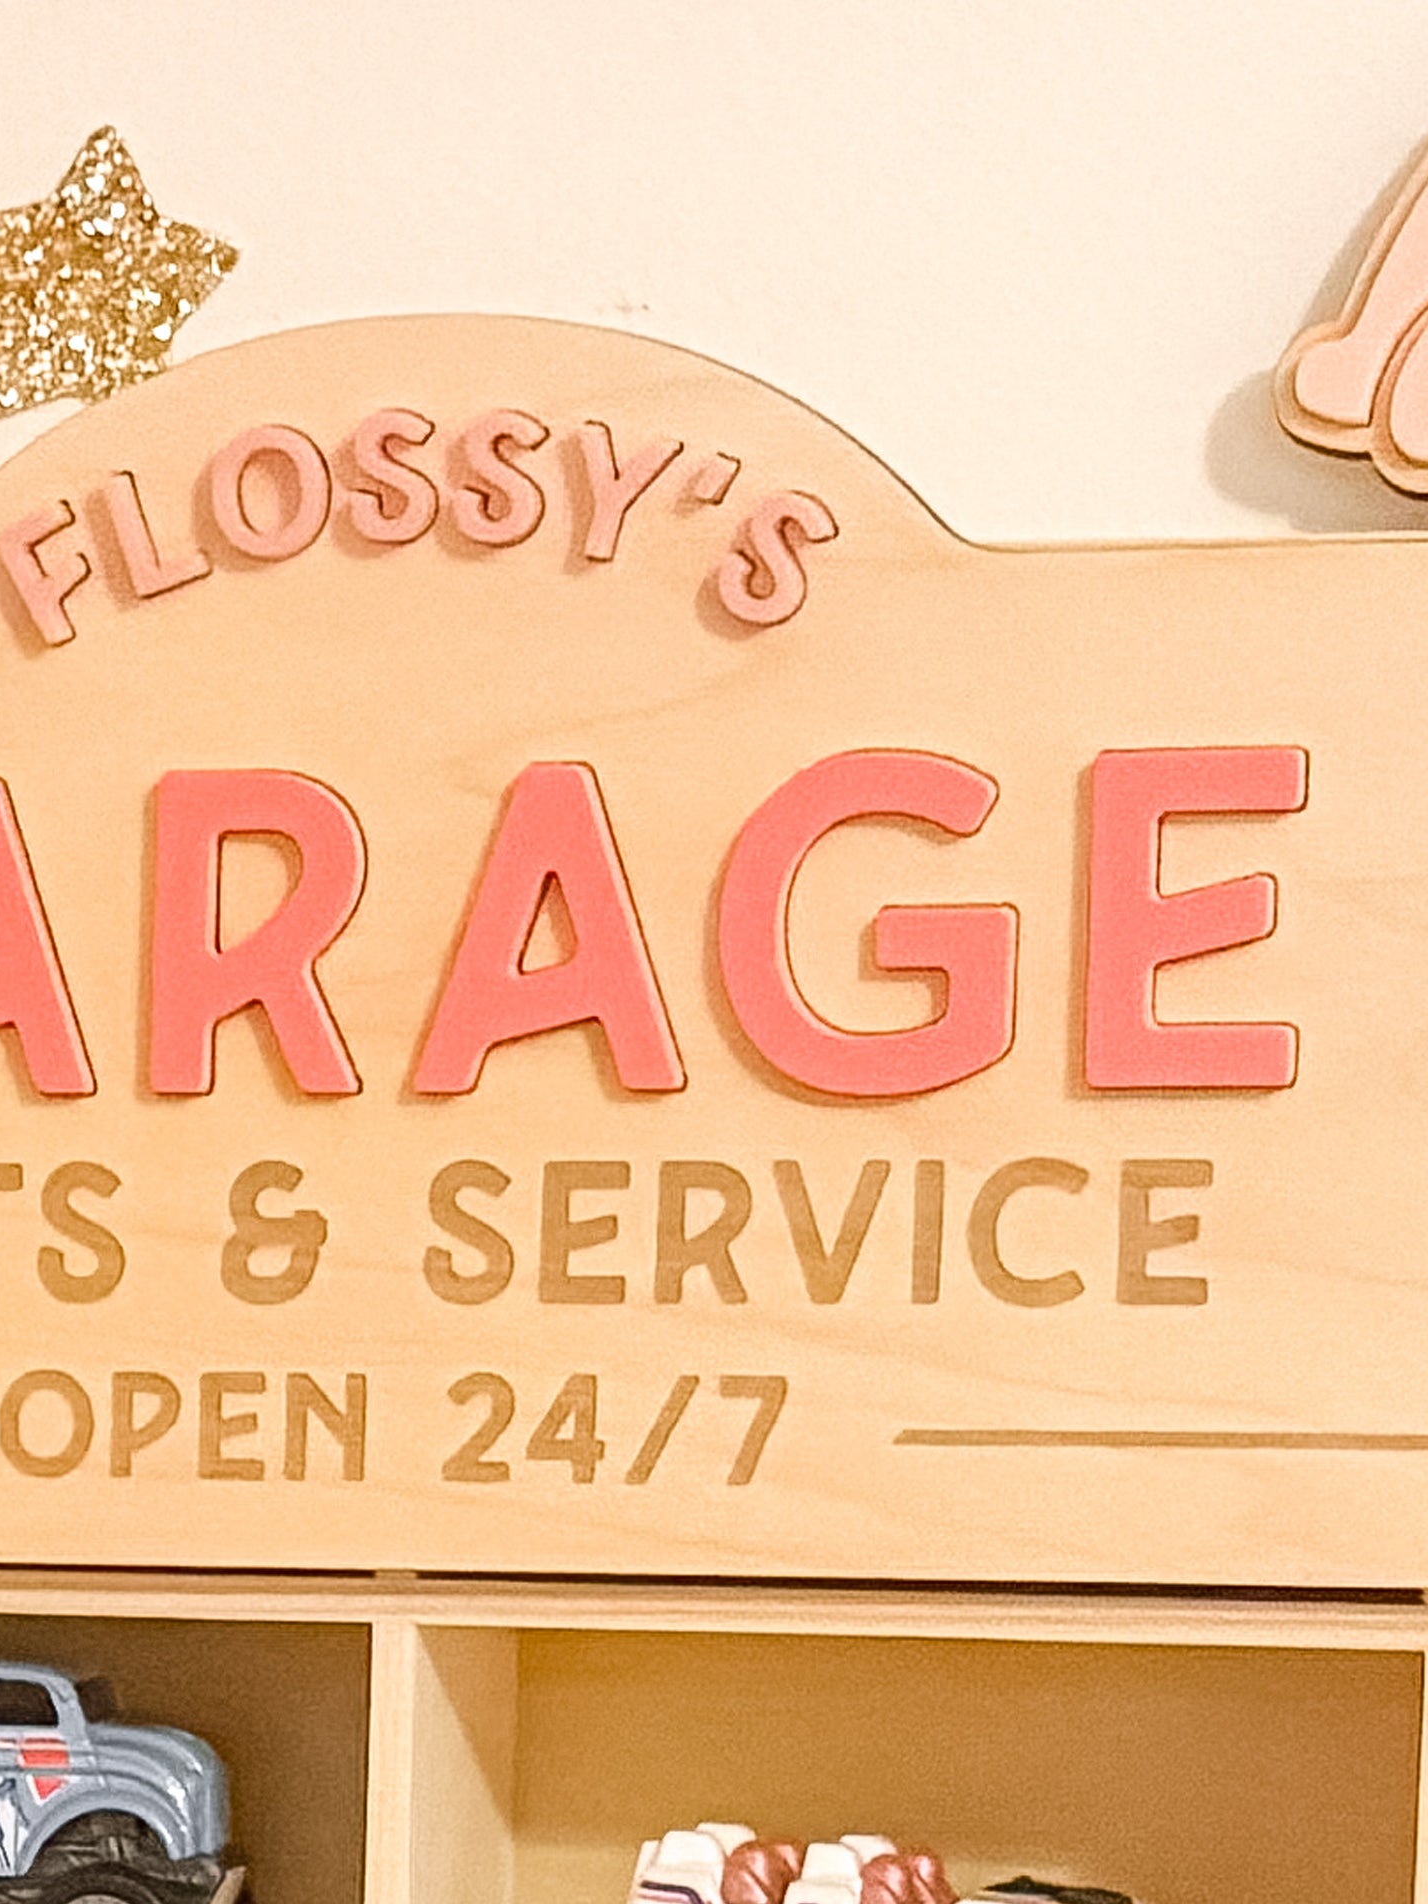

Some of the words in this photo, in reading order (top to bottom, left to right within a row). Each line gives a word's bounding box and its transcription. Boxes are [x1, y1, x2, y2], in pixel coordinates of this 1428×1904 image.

[219, 1158, 330, 1303] &
[421, 1156, 1214, 1308] SERVICE
[440, 1370, 792, 1489] 24/7
